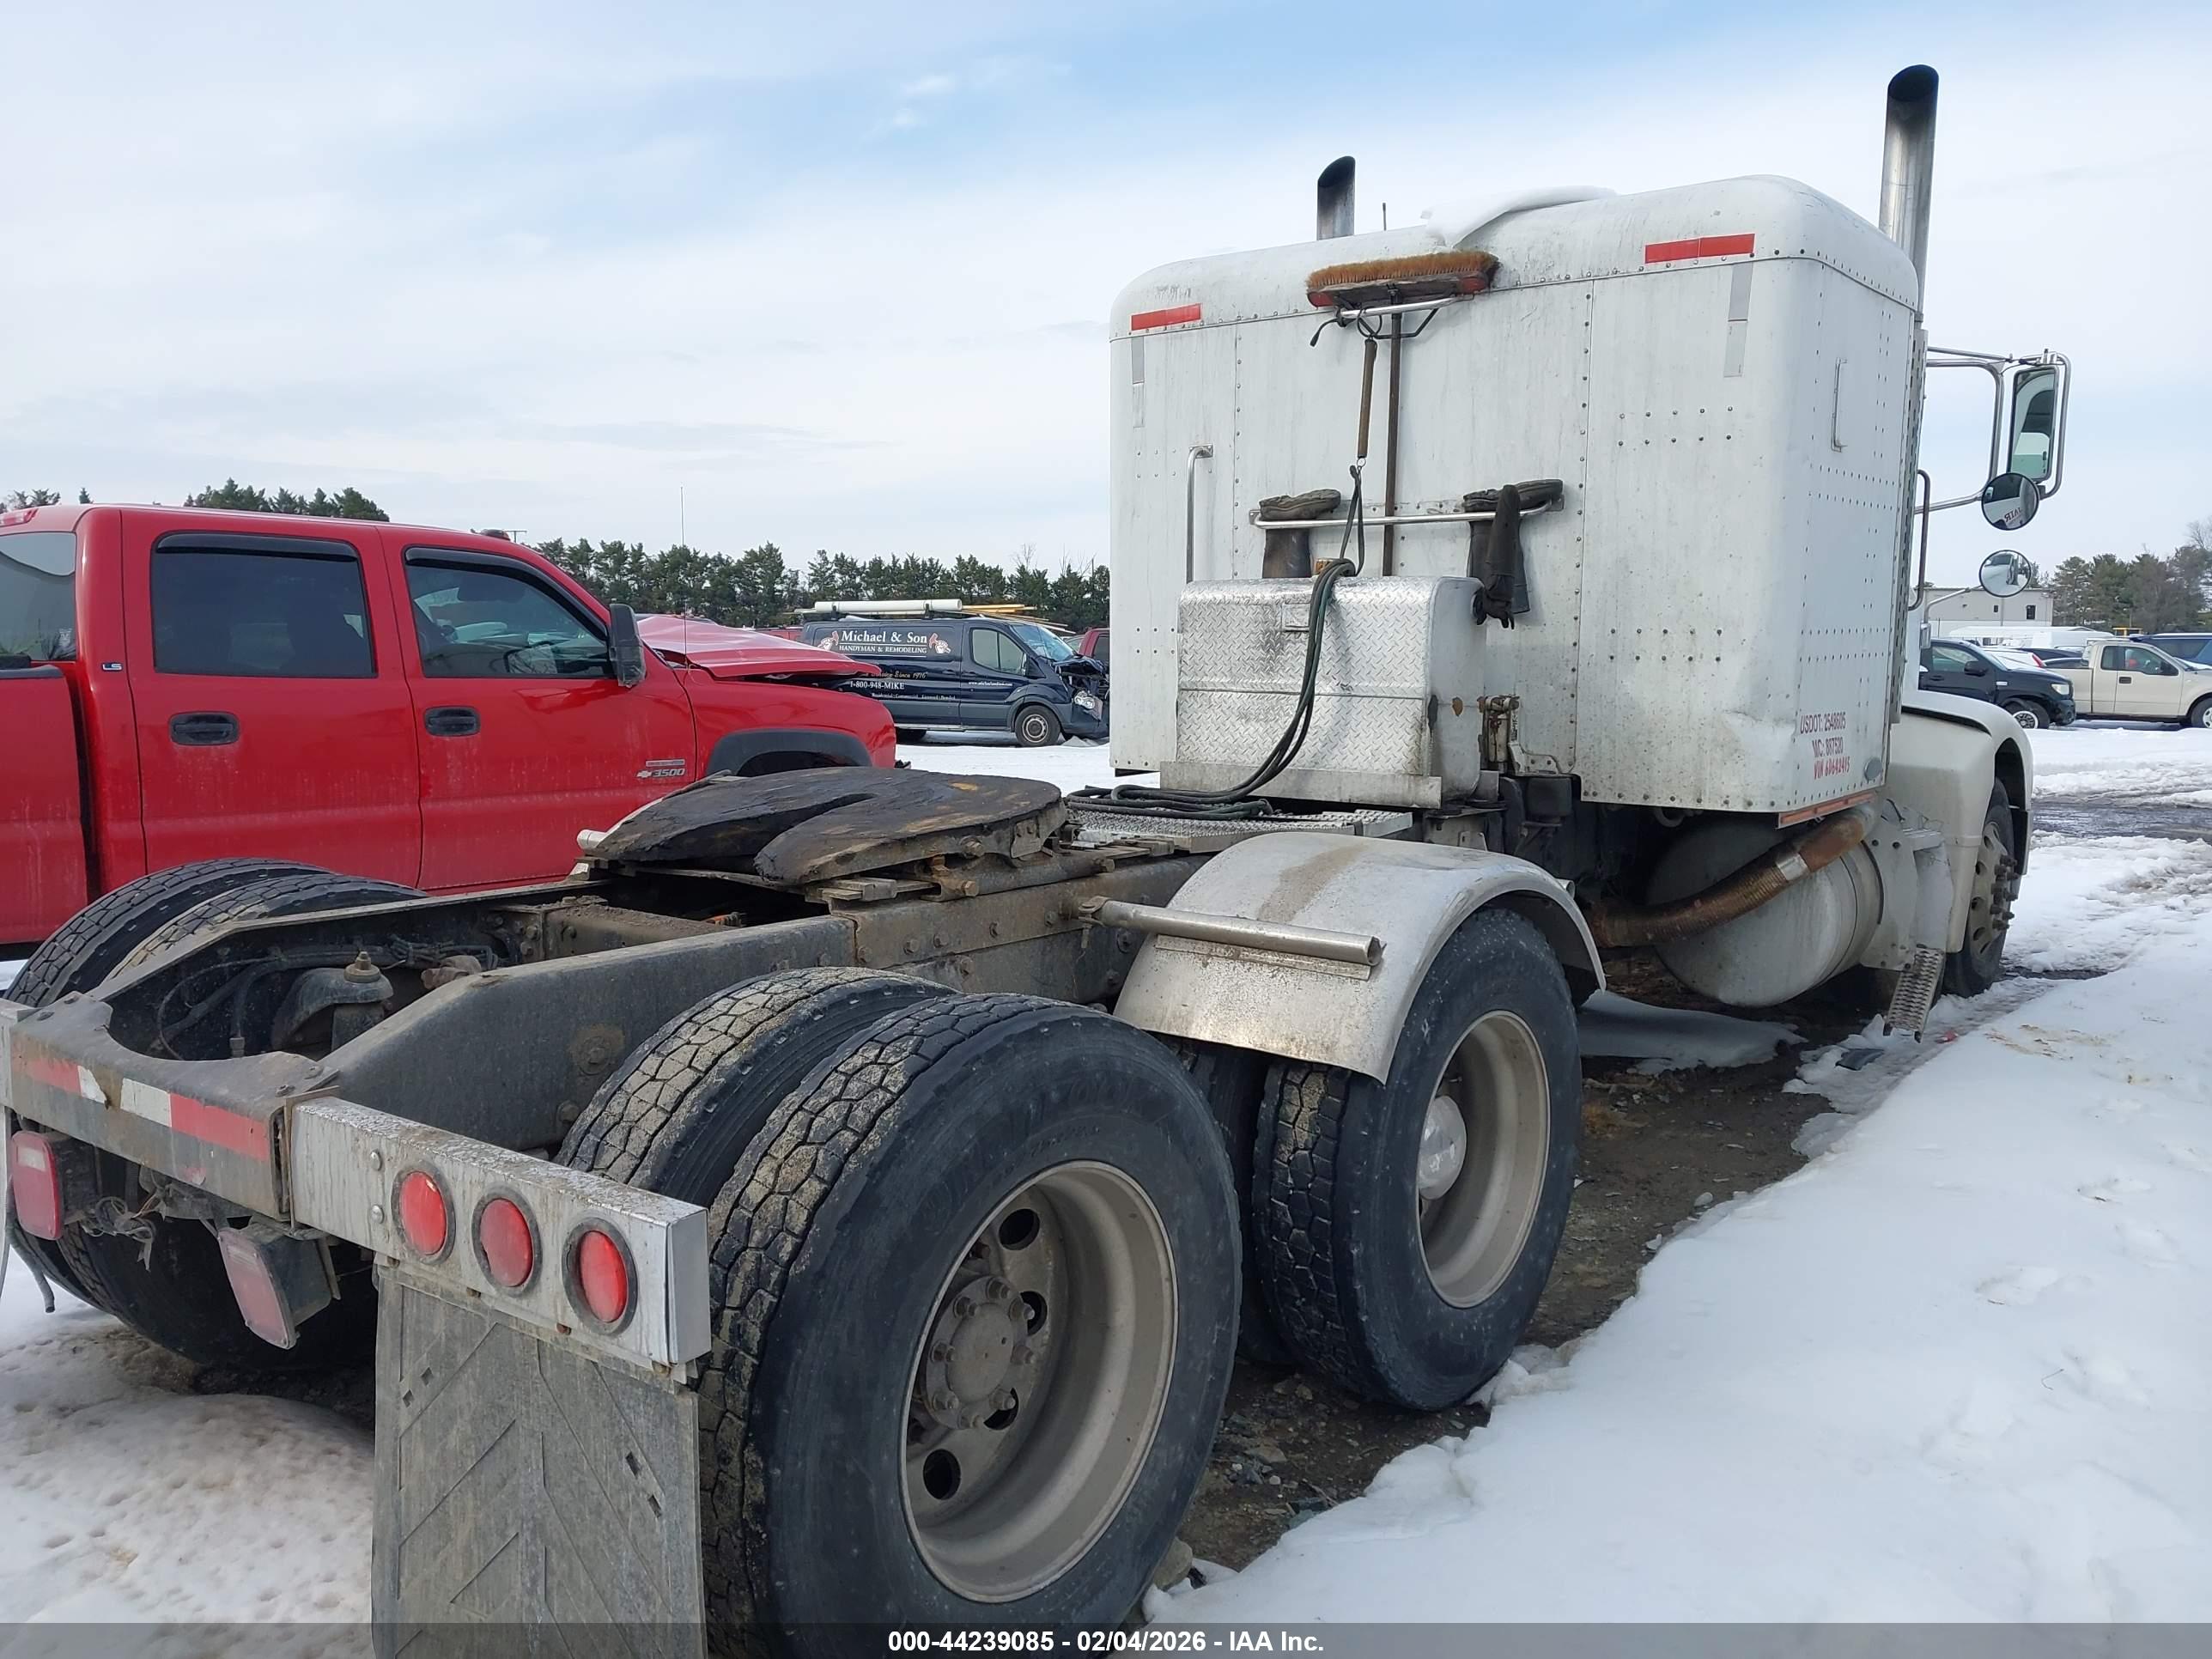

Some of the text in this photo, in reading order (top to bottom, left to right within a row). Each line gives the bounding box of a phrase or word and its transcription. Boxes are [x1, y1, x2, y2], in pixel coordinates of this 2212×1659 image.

[842, 630, 927, 644] Michael & Son
[850, 680, 905, 690] 1-800-948-MIKE
[1800, 714, 1823, 734] USDOT:
[1812, 738, 1825, 757] MC:
[653, 768, 685, 777] 3500
[1814, 759, 1824, 780] VIN
